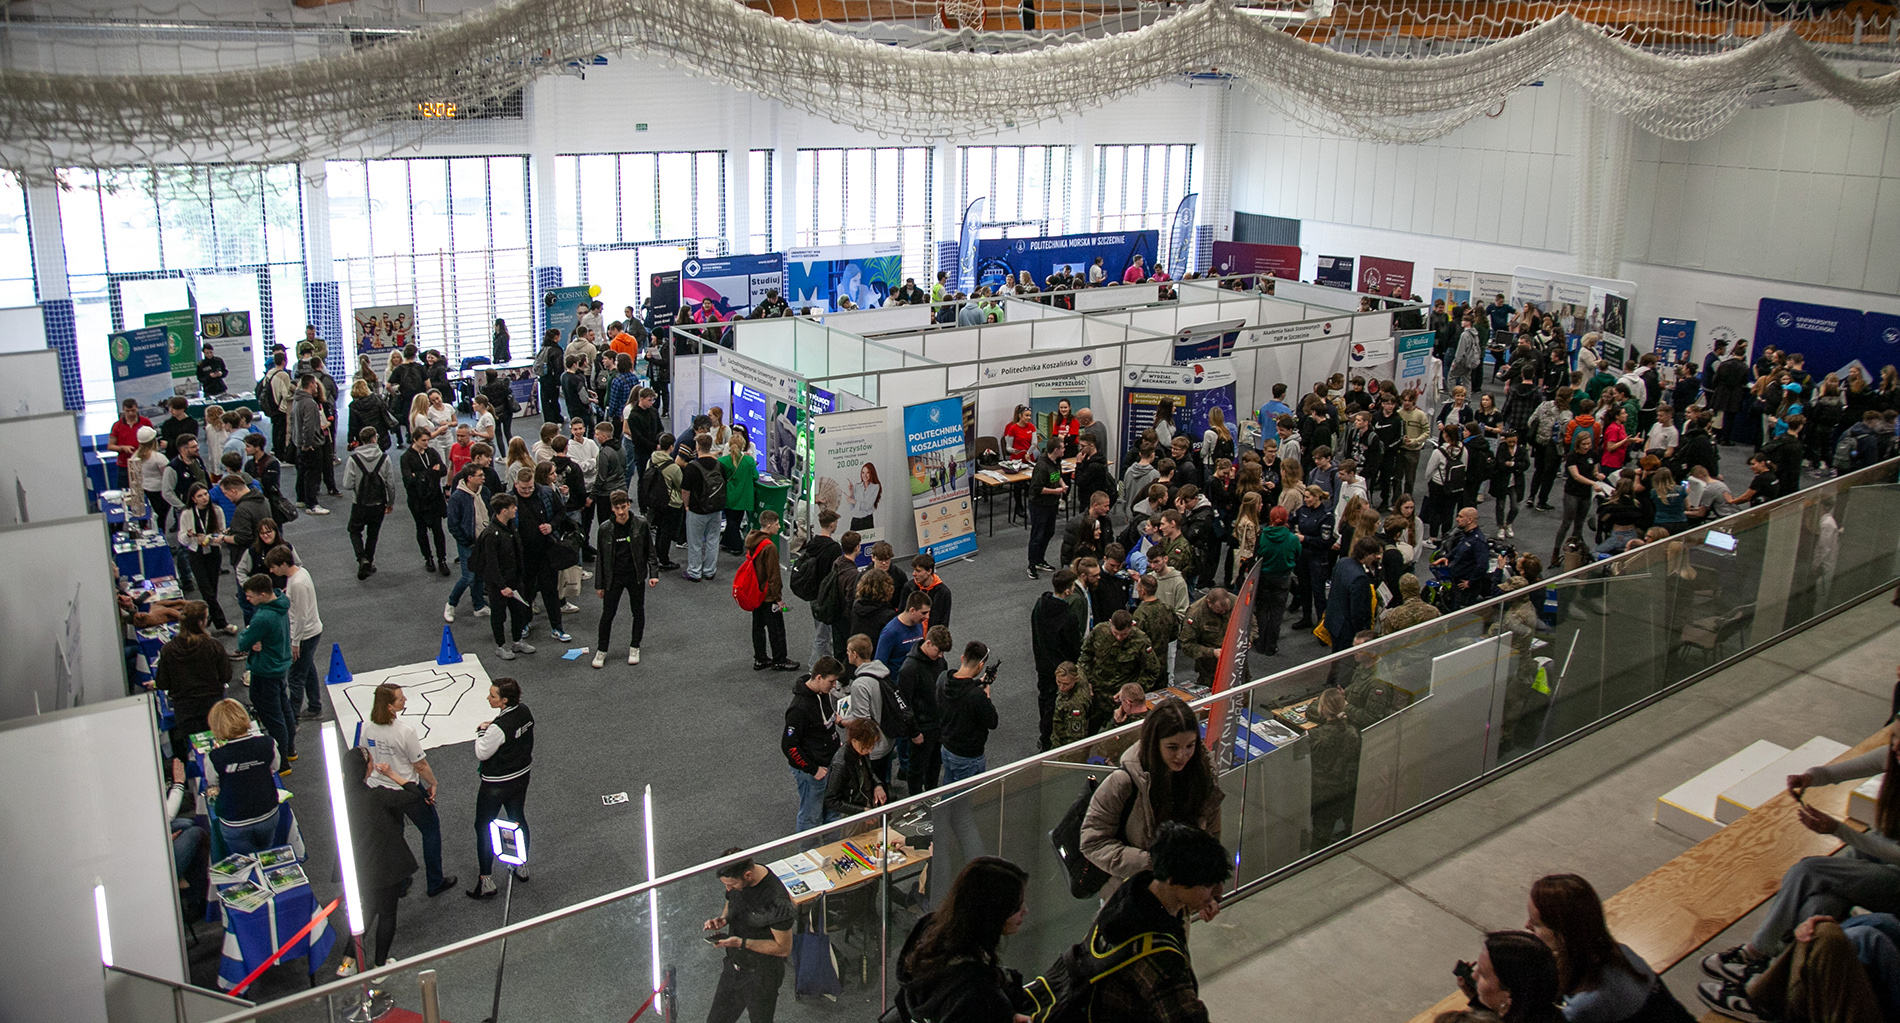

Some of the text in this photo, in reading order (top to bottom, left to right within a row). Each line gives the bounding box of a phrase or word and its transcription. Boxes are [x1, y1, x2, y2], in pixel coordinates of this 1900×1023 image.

[1030, 240, 1068, 250] POLITECHNIKA
[1069, 238, 1091, 247] MORSKA
[1098, 236, 1125, 245] SZCZECINIE
[752, 276, 780, 285] Studiuj
[557, 290, 589, 299] COSINUS
[1796, 316, 1838, 327] UNIWERSYTET
[1001, 359, 1078, 375] Politechnika Koszalińska
[908, 424, 962, 442] POLITECHNIKA
[828, 443, 873, 455] maturzystów
[911, 435, 963, 453] KOSZALIŃSKA
[837, 459, 859, 469] 20.000
